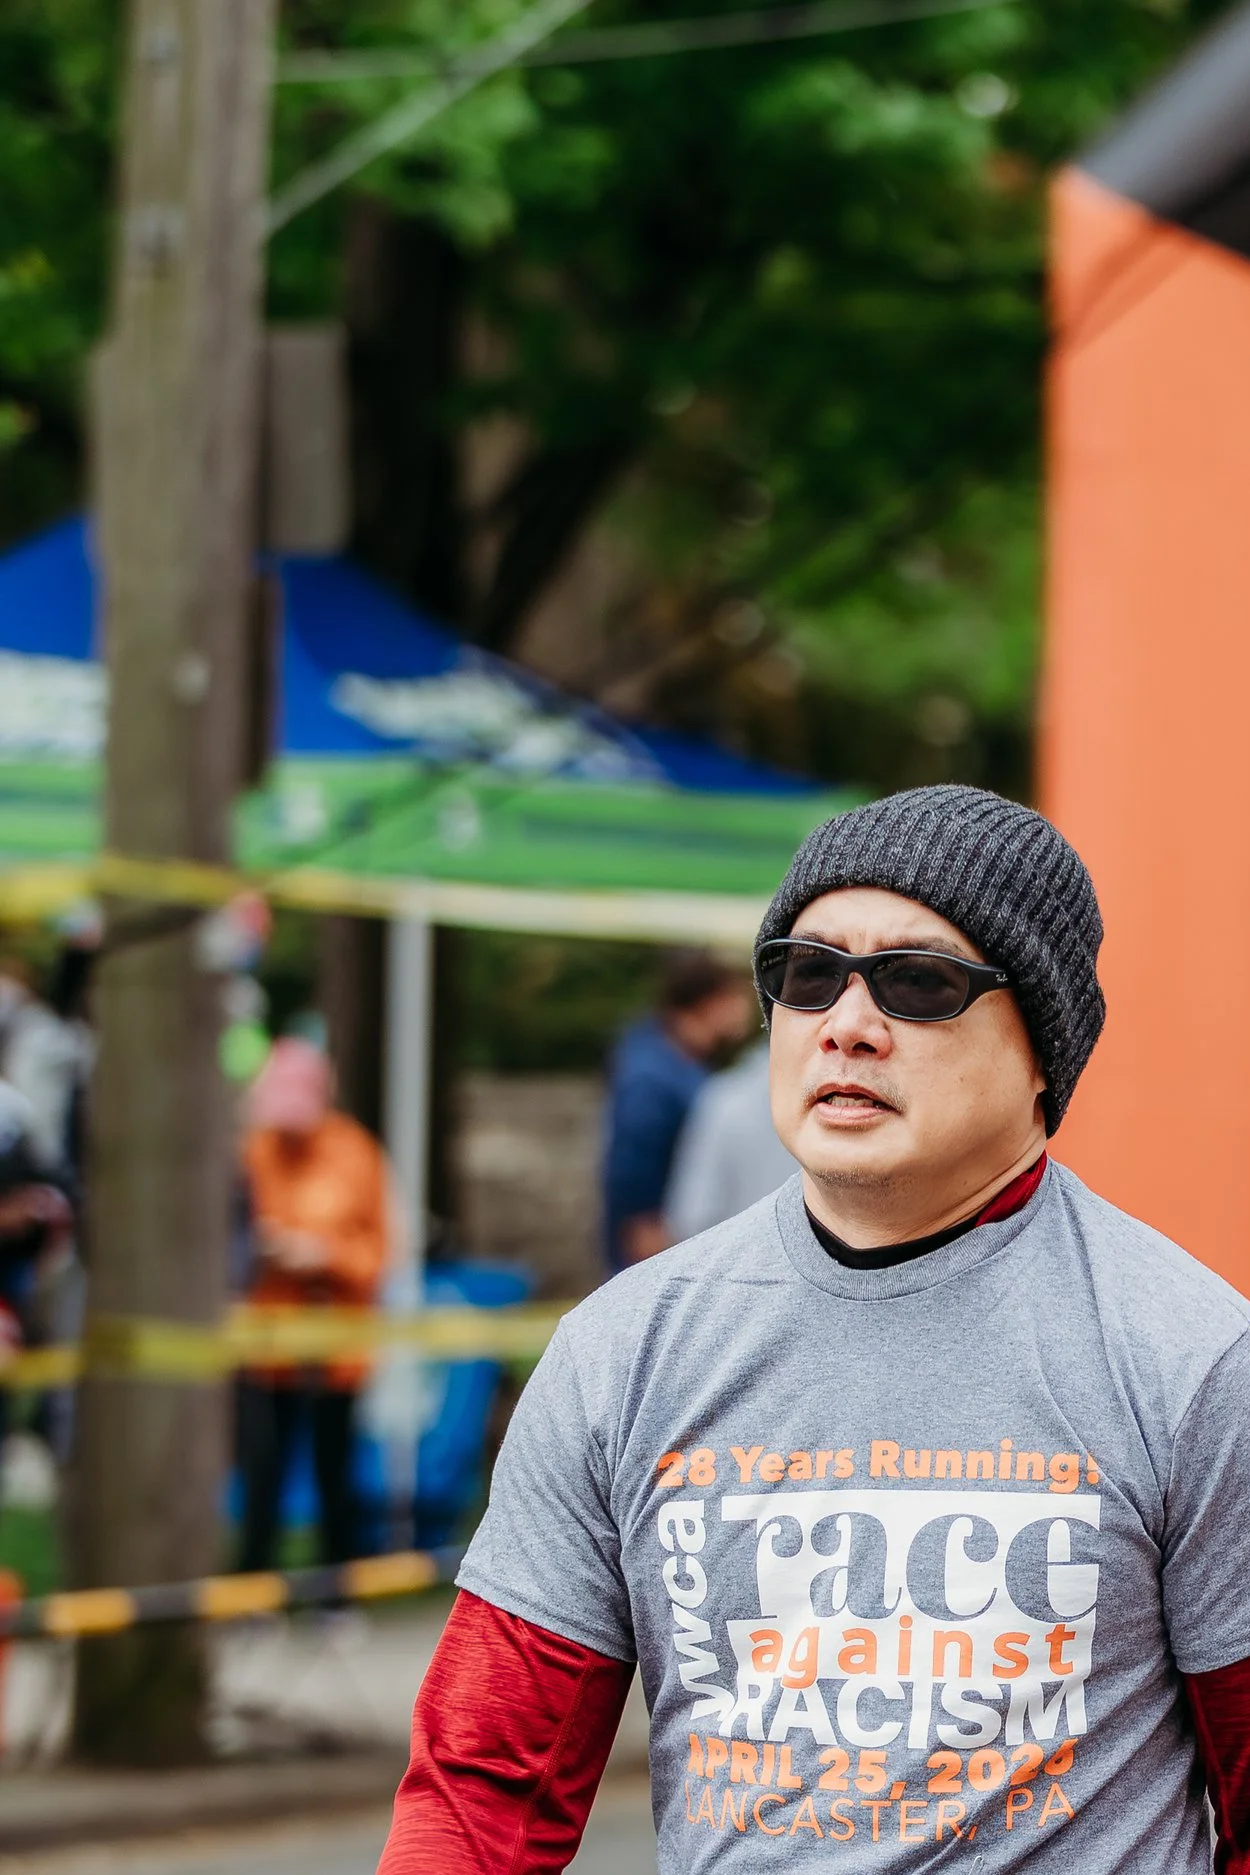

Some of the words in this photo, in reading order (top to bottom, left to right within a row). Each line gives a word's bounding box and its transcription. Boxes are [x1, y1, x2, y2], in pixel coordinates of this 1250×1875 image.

[656, 1450, 716, 1488] 28
[730, 1445, 855, 1482] Years
[870, 1438, 1100, 1493] Running!
[722, 1512, 1100, 1623] race
[658, 1499, 735, 1721] ywca
[750, 1615, 1077, 1688] against
[718, 1676, 1088, 1749] RACISM
[687, 1733, 802, 1789] APRIL
[817, 1746, 906, 1800] 25,
[926, 1738, 1079, 1792] 2026
[685, 1779, 978, 1844] LANCASTER,
[1005, 1781, 1076, 1831] PA
